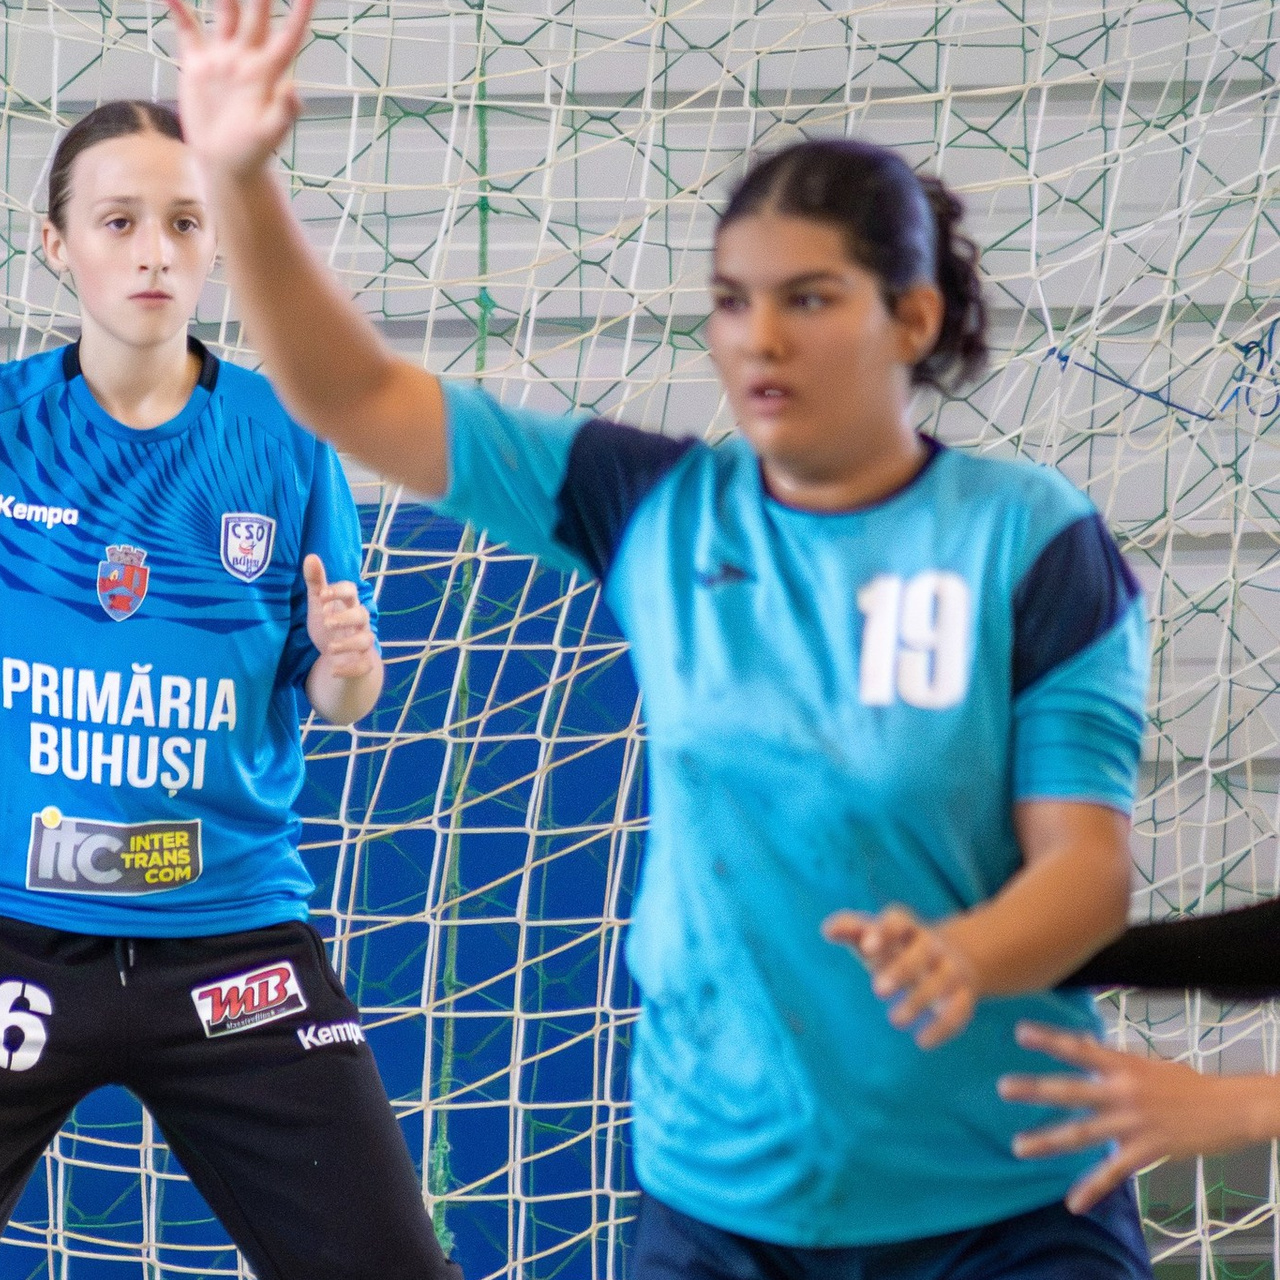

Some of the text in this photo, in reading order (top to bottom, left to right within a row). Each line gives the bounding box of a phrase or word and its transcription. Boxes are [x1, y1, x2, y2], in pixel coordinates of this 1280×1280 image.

[857, 570, 973, 710] 19
[2, 657, 237, 732] PRIMĂRIA
[130, 831, 189, 852] INTER
[121, 848, 192, 869] TRANS
[145, 866, 192, 884] COM
[297, 1022, 365, 1051] Kemp
